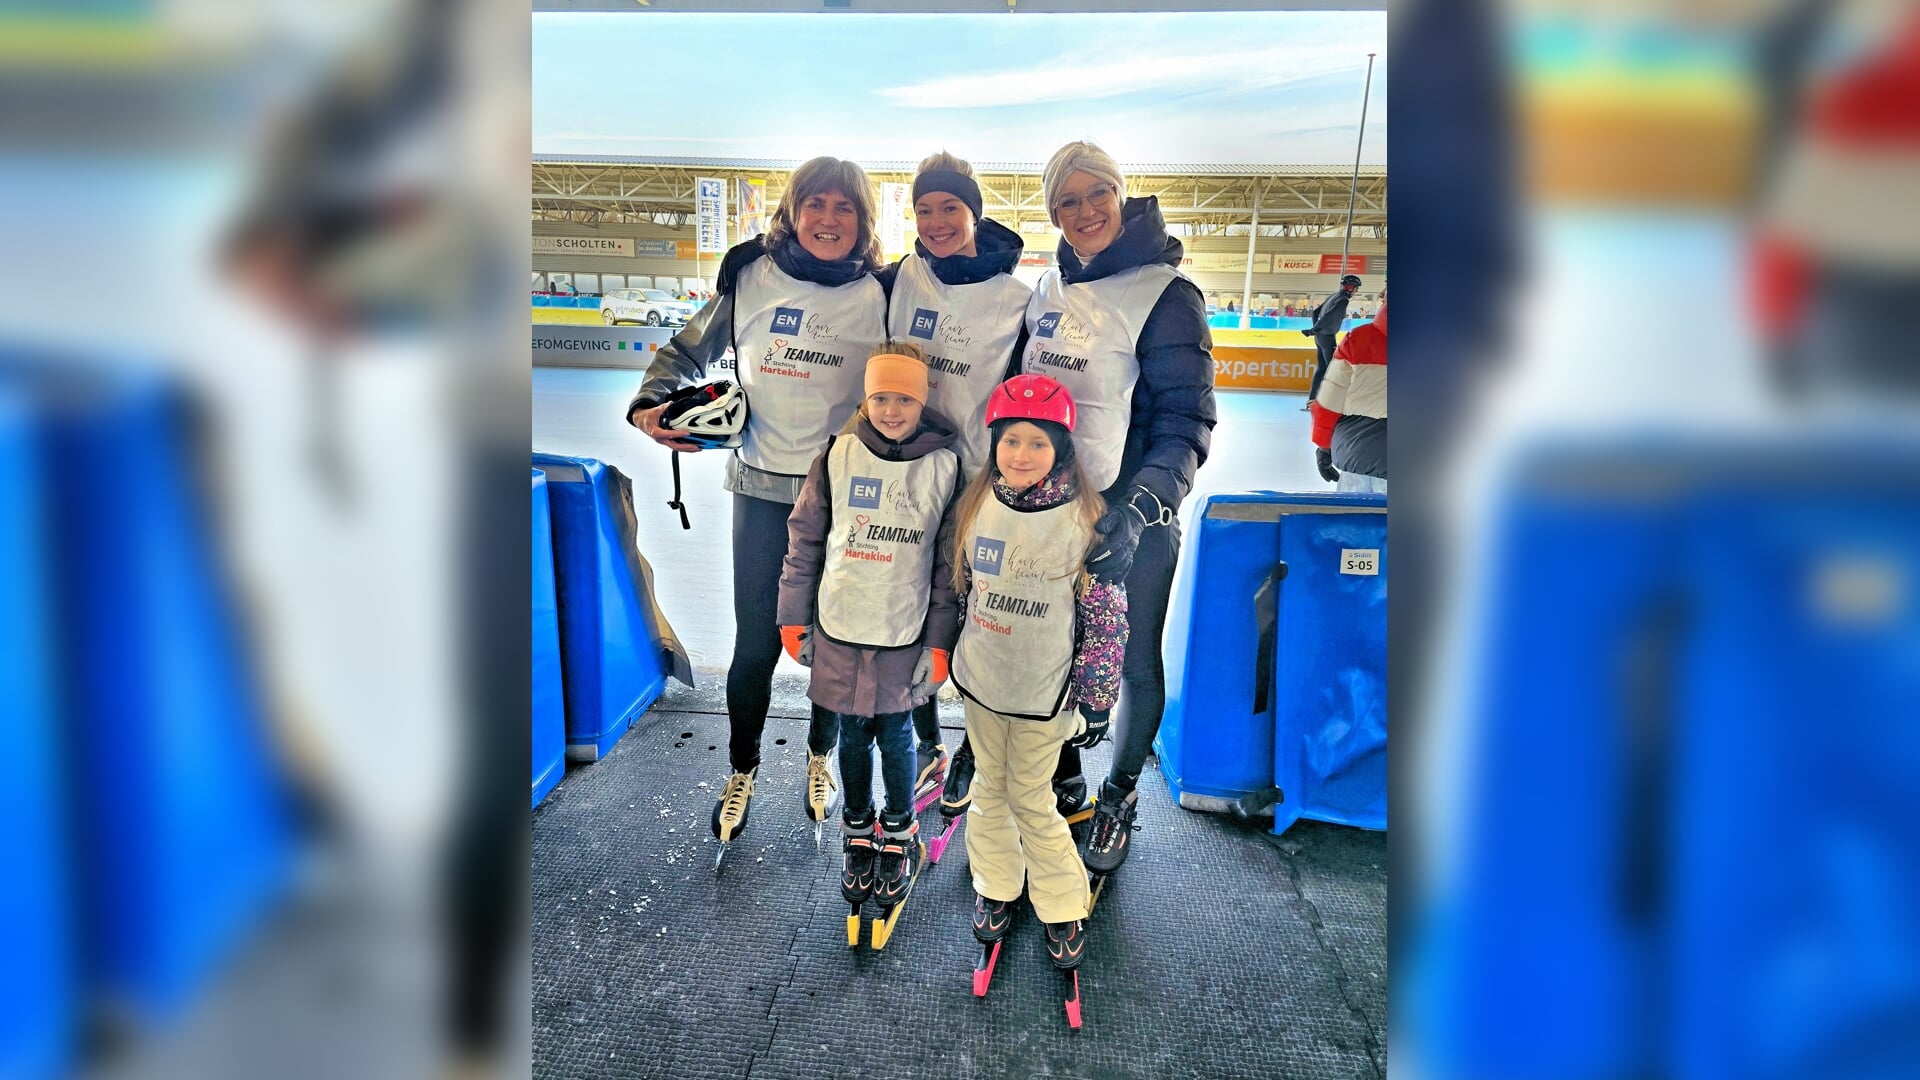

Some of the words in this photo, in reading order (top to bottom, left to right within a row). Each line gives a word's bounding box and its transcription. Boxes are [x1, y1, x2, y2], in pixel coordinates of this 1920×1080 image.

[701, 200, 713, 213] DE
[701, 216, 713, 248] MEENT
[775, 314, 798, 326] EN
[914, 316, 934, 329] EN
[1039, 319, 1057, 329] EN
[784, 347, 844, 368] TEAMTIJN!
[1039, 351, 1088, 372] TEAMTIJN!
[760, 365, 810, 379] Hartekind
[927, 355, 971, 377] AMTIJN!
[854, 484, 877, 498] EN
[866, 525, 924, 545] TEAMTIJN!
[856, 542, 879, 551] Stichting
[845, 548, 893, 562] Hartekind
[977, 546, 999, 562] EN
[1347, 560, 1373, 570] S-05
[985, 592, 1050, 619] TEAMTIJN!
